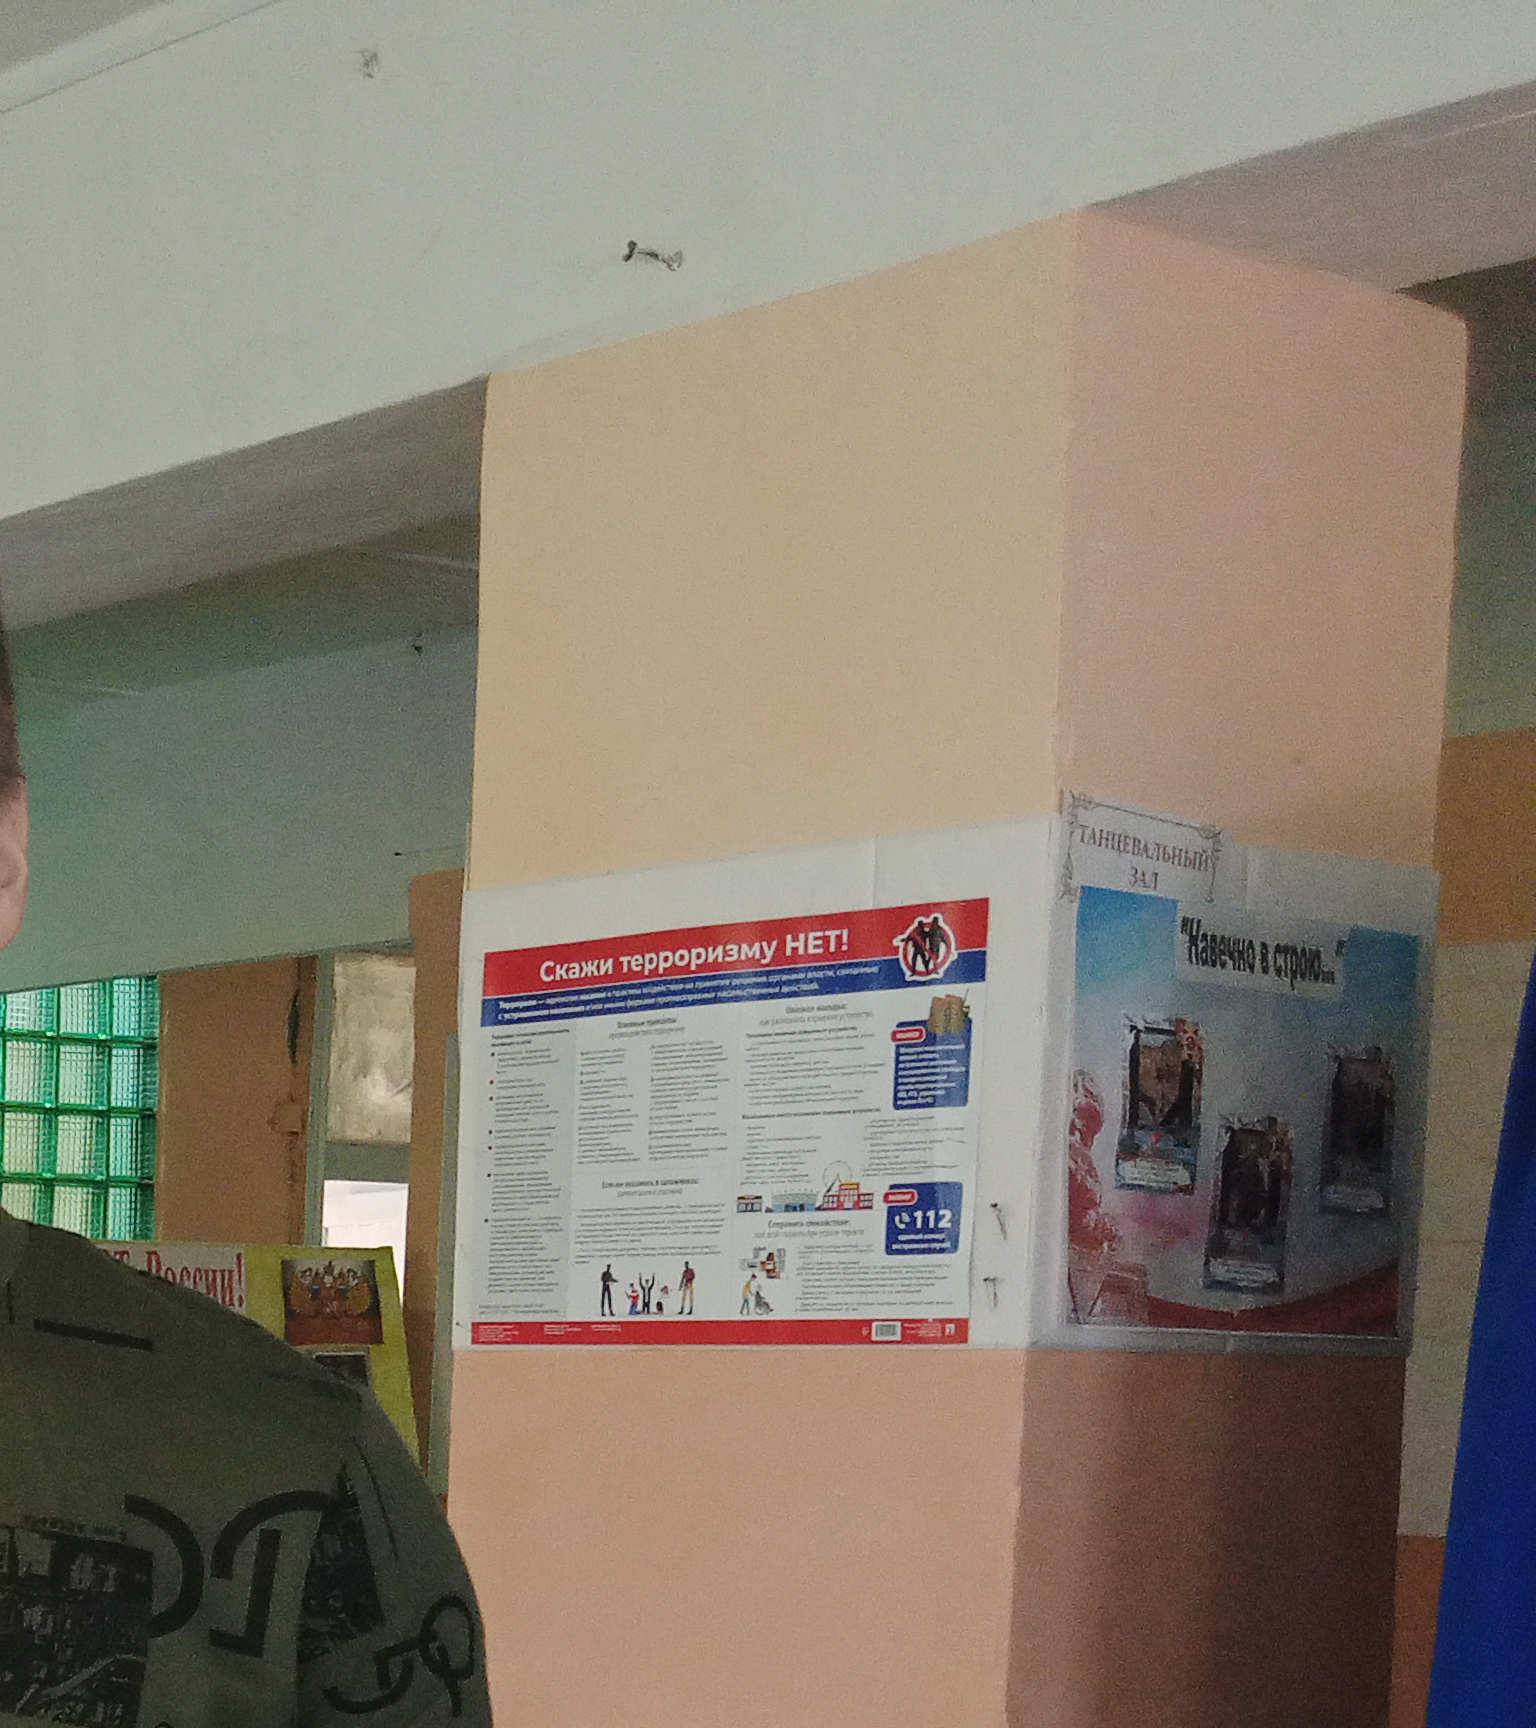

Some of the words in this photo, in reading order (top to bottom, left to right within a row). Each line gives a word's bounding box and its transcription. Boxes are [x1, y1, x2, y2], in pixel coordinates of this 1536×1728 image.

[1078, 823, 1210, 872] ТАНЦЕВАЛЬНЫЙ
[1129, 867, 1160, 892] ЗАЛ
[539, 955, 614, 983] Скажи
[620, 940, 778, 975] терроризму
[785, 929, 850, 957] НЕТ!
[913, 1208, 953, 1229] 112
